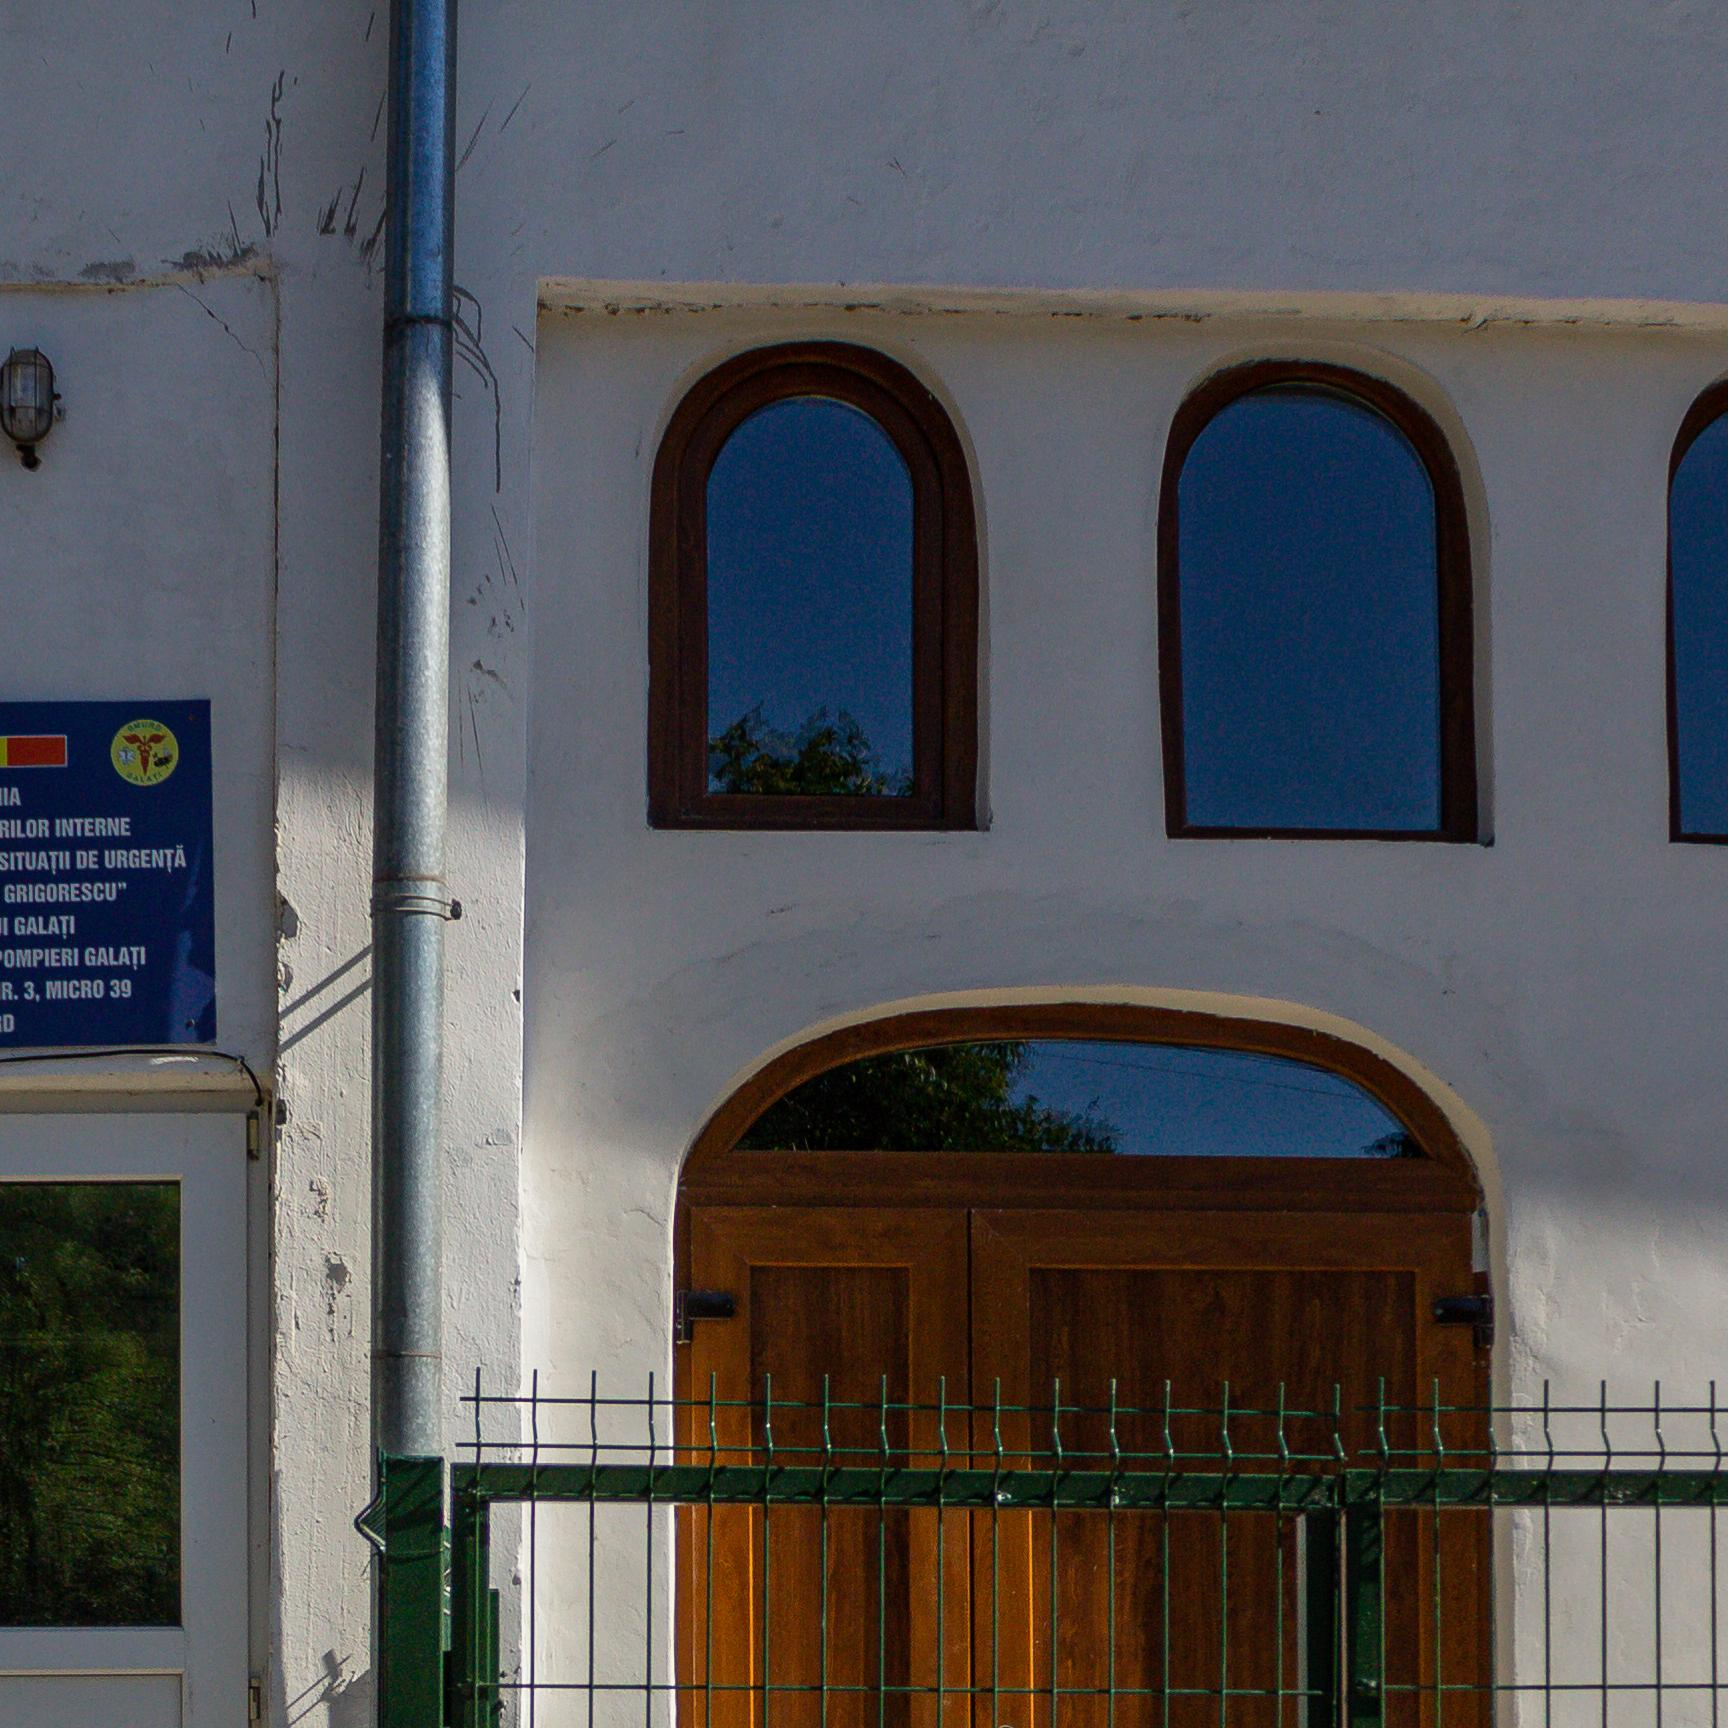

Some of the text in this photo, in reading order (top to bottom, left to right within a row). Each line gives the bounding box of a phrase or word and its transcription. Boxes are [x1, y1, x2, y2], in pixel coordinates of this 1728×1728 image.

[55, 817, 131, 838] INTERNE
[75, 849, 100, 870] DE
[104, 844, 187, 873] URGENȚĂ
[14, 915, 75, 940] GALAȚI
[84, 945, 147, 971] GALAȚI
[23, 980, 40, 1003] 3,
[45, 978, 105, 1000] MICRO
[109, 978, 132, 998] 39
